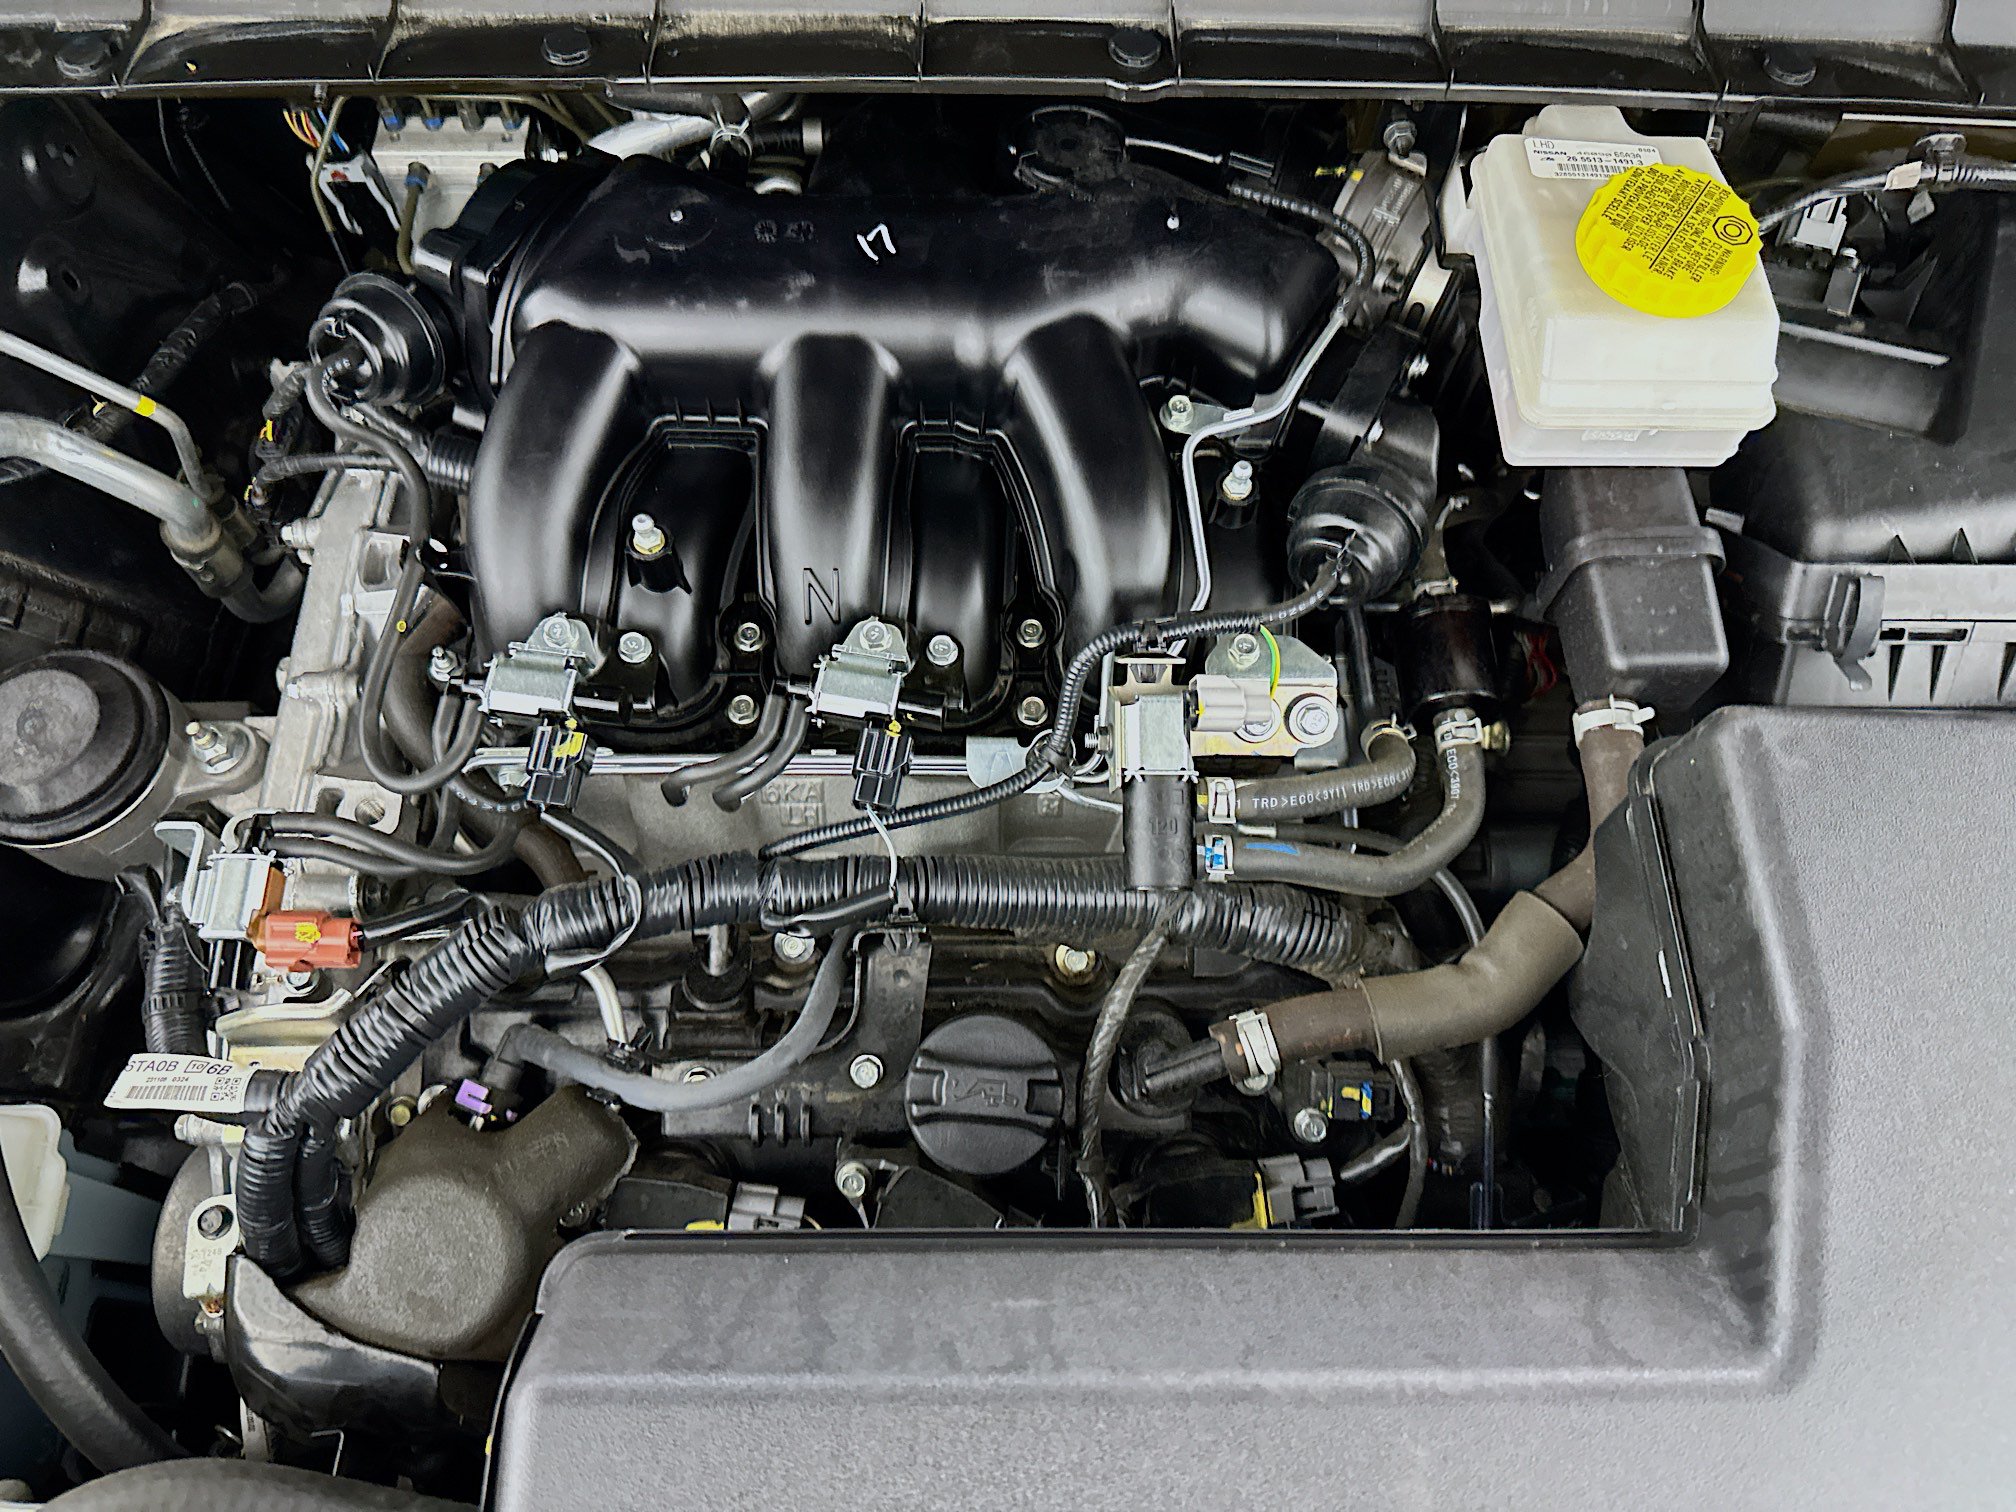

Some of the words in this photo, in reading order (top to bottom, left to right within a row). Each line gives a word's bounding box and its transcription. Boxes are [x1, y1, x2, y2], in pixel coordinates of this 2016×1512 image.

[1617, 167, 1645, 199] CONTENANT
[1645, 167, 1659, 180] DOT
[1666, 168, 1685, 189] AVANT
[1620, 182, 1648, 215] PROVENANT
[1641, 172, 1670, 205] SEULEMENT
[1660, 186, 1673, 197] DE
[1668, 179, 1691, 205] BOUCHON
[1703, 183, 1720, 200] FLUID
[1635, 202, 1648, 213] DU
[1662, 202, 1675, 213] DE
[1692, 199, 1710, 217] FROM
[1619, 210, 1642, 234] LIQUIDE
[1636, 210, 1670, 250] REMPLISSAGE
[1673, 220, 1695, 244] SEALED
[1697, 216, 1712, 230] USE
[1620, 225, 1645, 251] UTILISER
[1648, 223, 1674, 253] NETTOYER
[1688, 227, 1704, 243] ONLY
[1698, 237, 1712, 251] CAP
[1642, 251, 1655, 261] LE
[1680, 241, 1694, 255] DOT
[1703, 242, 1722, 263] CLEAN
[1663, 257, 1683, 280] BRAKE
[1681, 250, 1703, 274] BEFORE
[1690, 260, 1710, 283] FILLER
[802, 567, 841, 625] N
[206, 1064, 232, 1075] 6B
